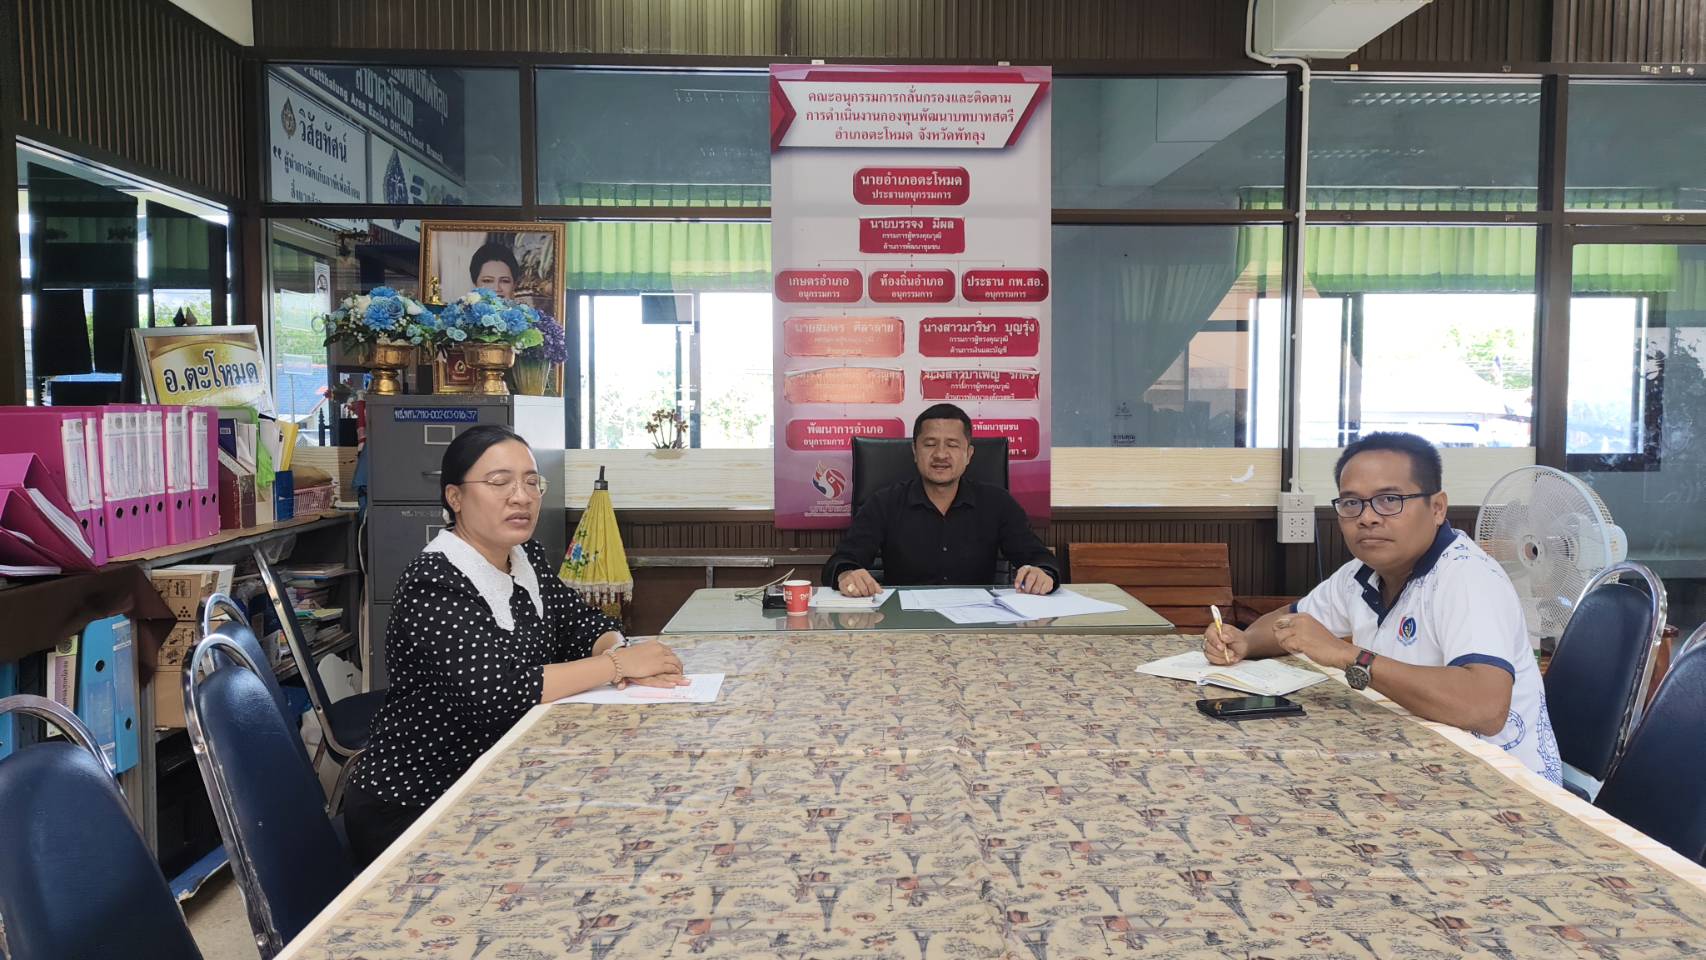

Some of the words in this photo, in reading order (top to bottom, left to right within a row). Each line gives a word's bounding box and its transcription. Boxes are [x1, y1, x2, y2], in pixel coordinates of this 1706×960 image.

[808, 85, 1012, 107] คณะอนุกรรมการกลั่นกรองและติดตาม
[806, 107, 1016, 126] การดำเนินงานกองทุนพัฒนาบทบาทสตรี
[298, 107, 348, 163] วิสัยทัศน์
[834, 126, 913, 141] อำเภอตะโหมด
[919, 126, 986, 146] จังหวัดพัทลุง
[860, 171, 963, 187] นายอำเภอตะโหมด
[871, 189, 952, 203] ประธานอนุกรรมการ
[869, 219, 924, 230] นายบรรจง
[788, 273, 849, 287] เกษตรอำเภอ
[880, 271, 944, 287] ท้องถิ่นอำเภอ
[966, 275, 1004, 287] ประธาน
[798, 290, 841, 301] อนุกรรมการ
[891, 290, 934, 301] อนุกรรมการ
[984, 290, 1027, 301] อนุกรรมการ
[923, 320, 997, 334] นางสาวมาริษา
[1004, 321, 1035, 337] บุญรุ่ง
[163, 350, 260, 393] อ.ตะโหมด
[806, 422, 884, 435] พัฒนาการอำเภอ
[803, 438, 845, 448] อนุกรรมการ
